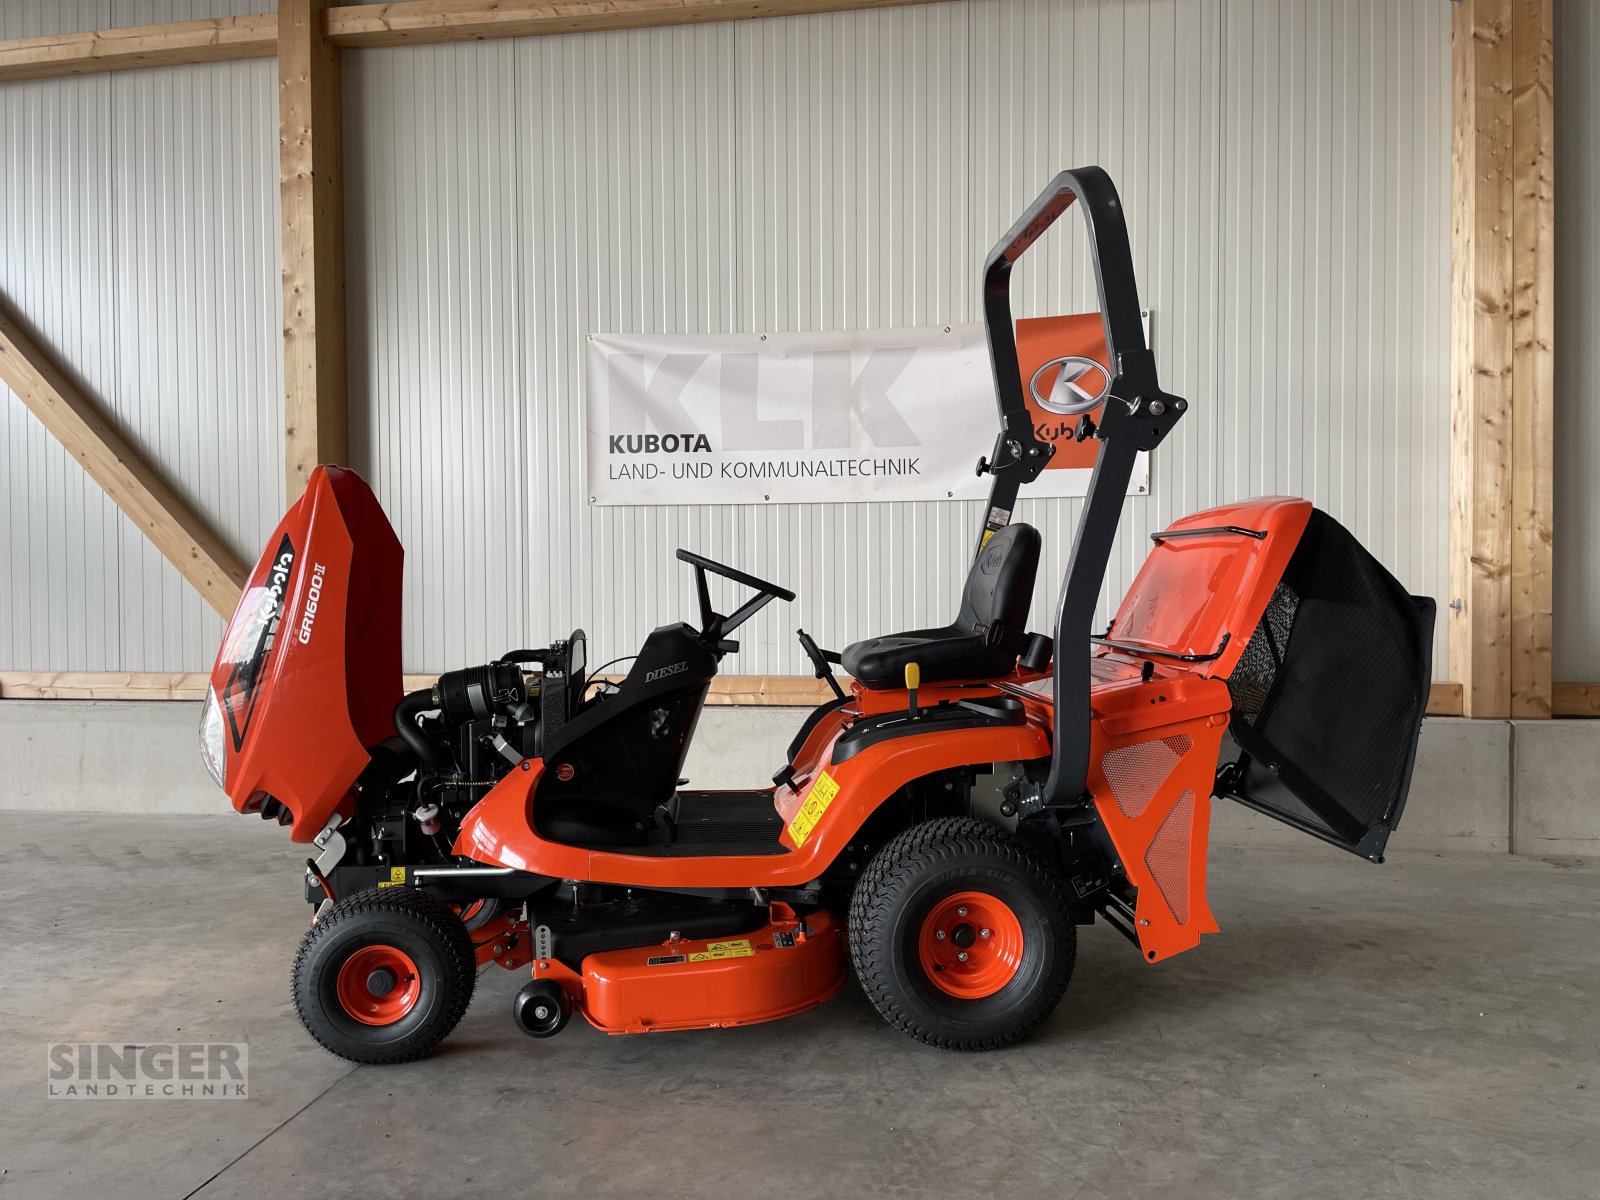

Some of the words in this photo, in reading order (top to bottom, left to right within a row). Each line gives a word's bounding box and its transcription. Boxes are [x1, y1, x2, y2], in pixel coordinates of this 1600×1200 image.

[607, 346, 923, 452] KLK
[608, 433, 713, 454] KUBOTA
[608, 463, 666, 480] LAND-
[672, 461, 714, 479] UND
[721, 457, 921, 479] KOMMUNALTECHNIK
[256, 552, 294, 625] Kubota
[644, 660, 689, 684] DIESEL
